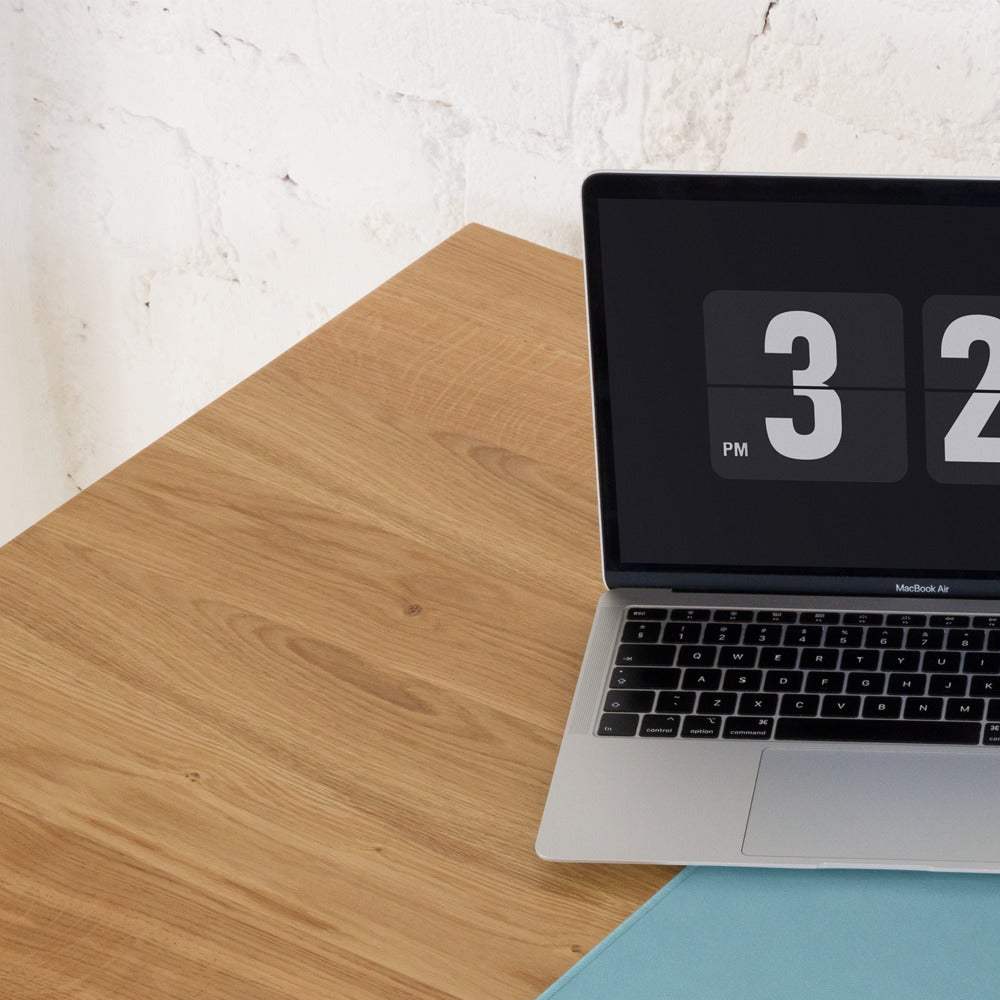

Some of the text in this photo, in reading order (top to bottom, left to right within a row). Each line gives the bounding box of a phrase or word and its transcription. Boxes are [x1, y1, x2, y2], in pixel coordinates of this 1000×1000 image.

[764, 310, 843, 461] 3
[722, 441, 749, 458] PM
[895, 583, 950, 594] MacBook Air
[718, 633, 726, 641] 2
[961, 639, 969, 647] 8
[692, 652, 702, 660] Q
[937, 658, 946, 666] U
[739, 676, 746, 684] S
[779, 677, 788, 685] D
[821, 678, 828, 686] F
[861, 679, 870, 687] G
[902, 680, 911, 688] H
[713, 699, 721, 707] Z
[795, 701, 804, 709] C
[878, 703, 886, 711] B
[919, 704, 928, 712] N
[960, 705, 970, 713] M
